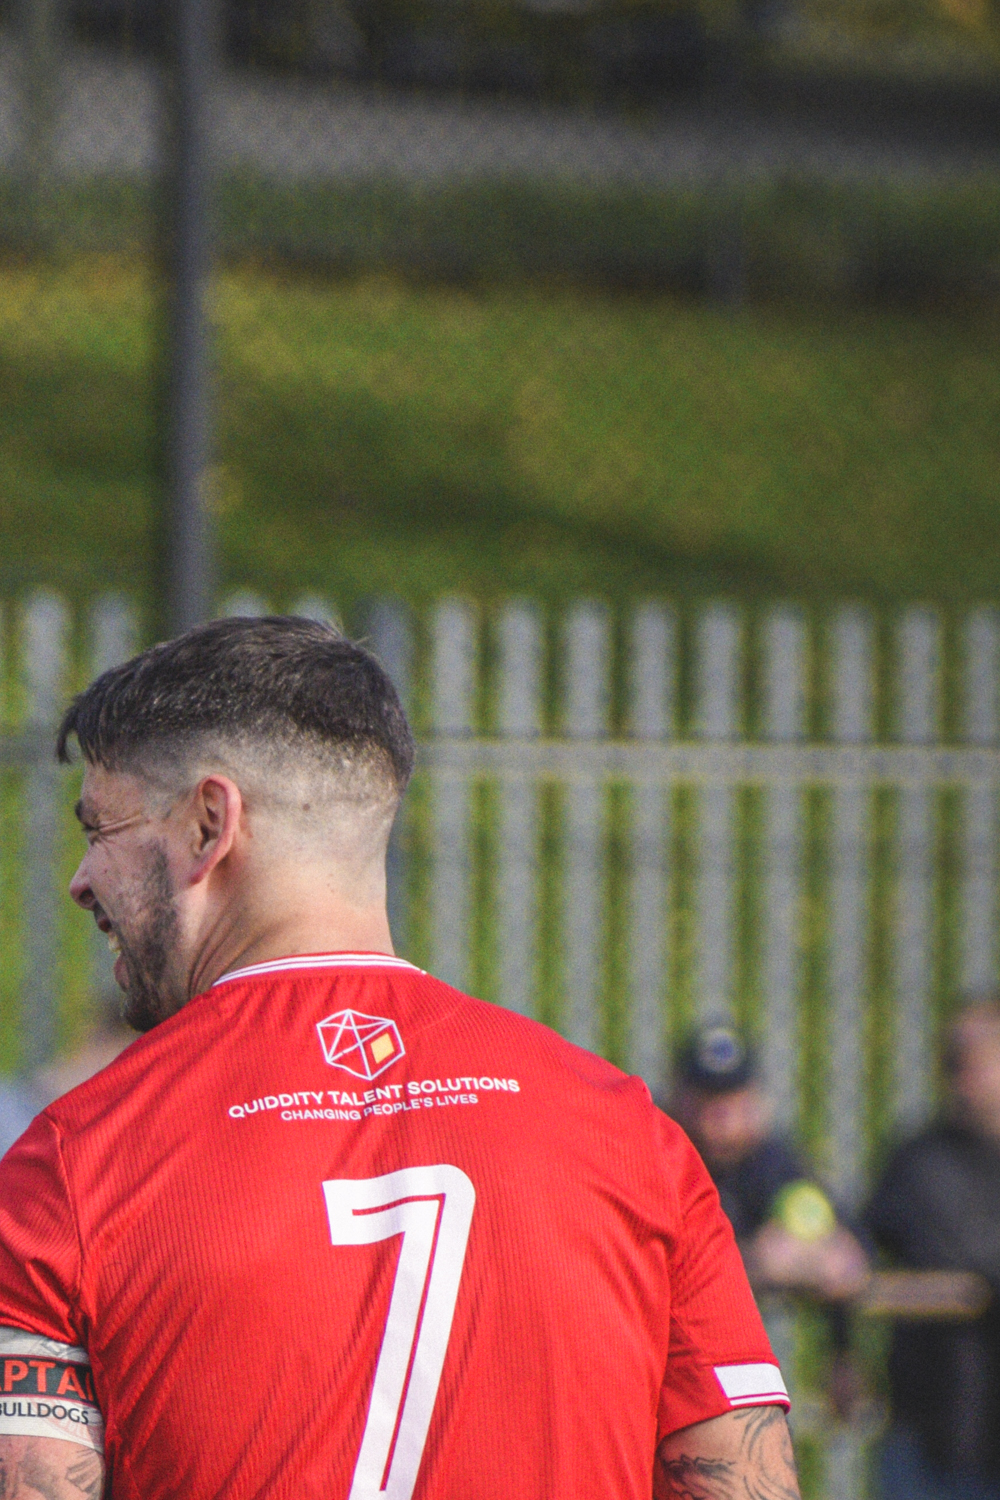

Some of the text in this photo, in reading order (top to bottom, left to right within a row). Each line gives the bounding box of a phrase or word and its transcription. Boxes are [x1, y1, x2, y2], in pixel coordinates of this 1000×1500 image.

[228, 1076, 521, 1119] QUIDDITY TALENT SOLUTIONS
[280, 1093, 479, 1121] CHANGING PEOPLE'S LIVES
